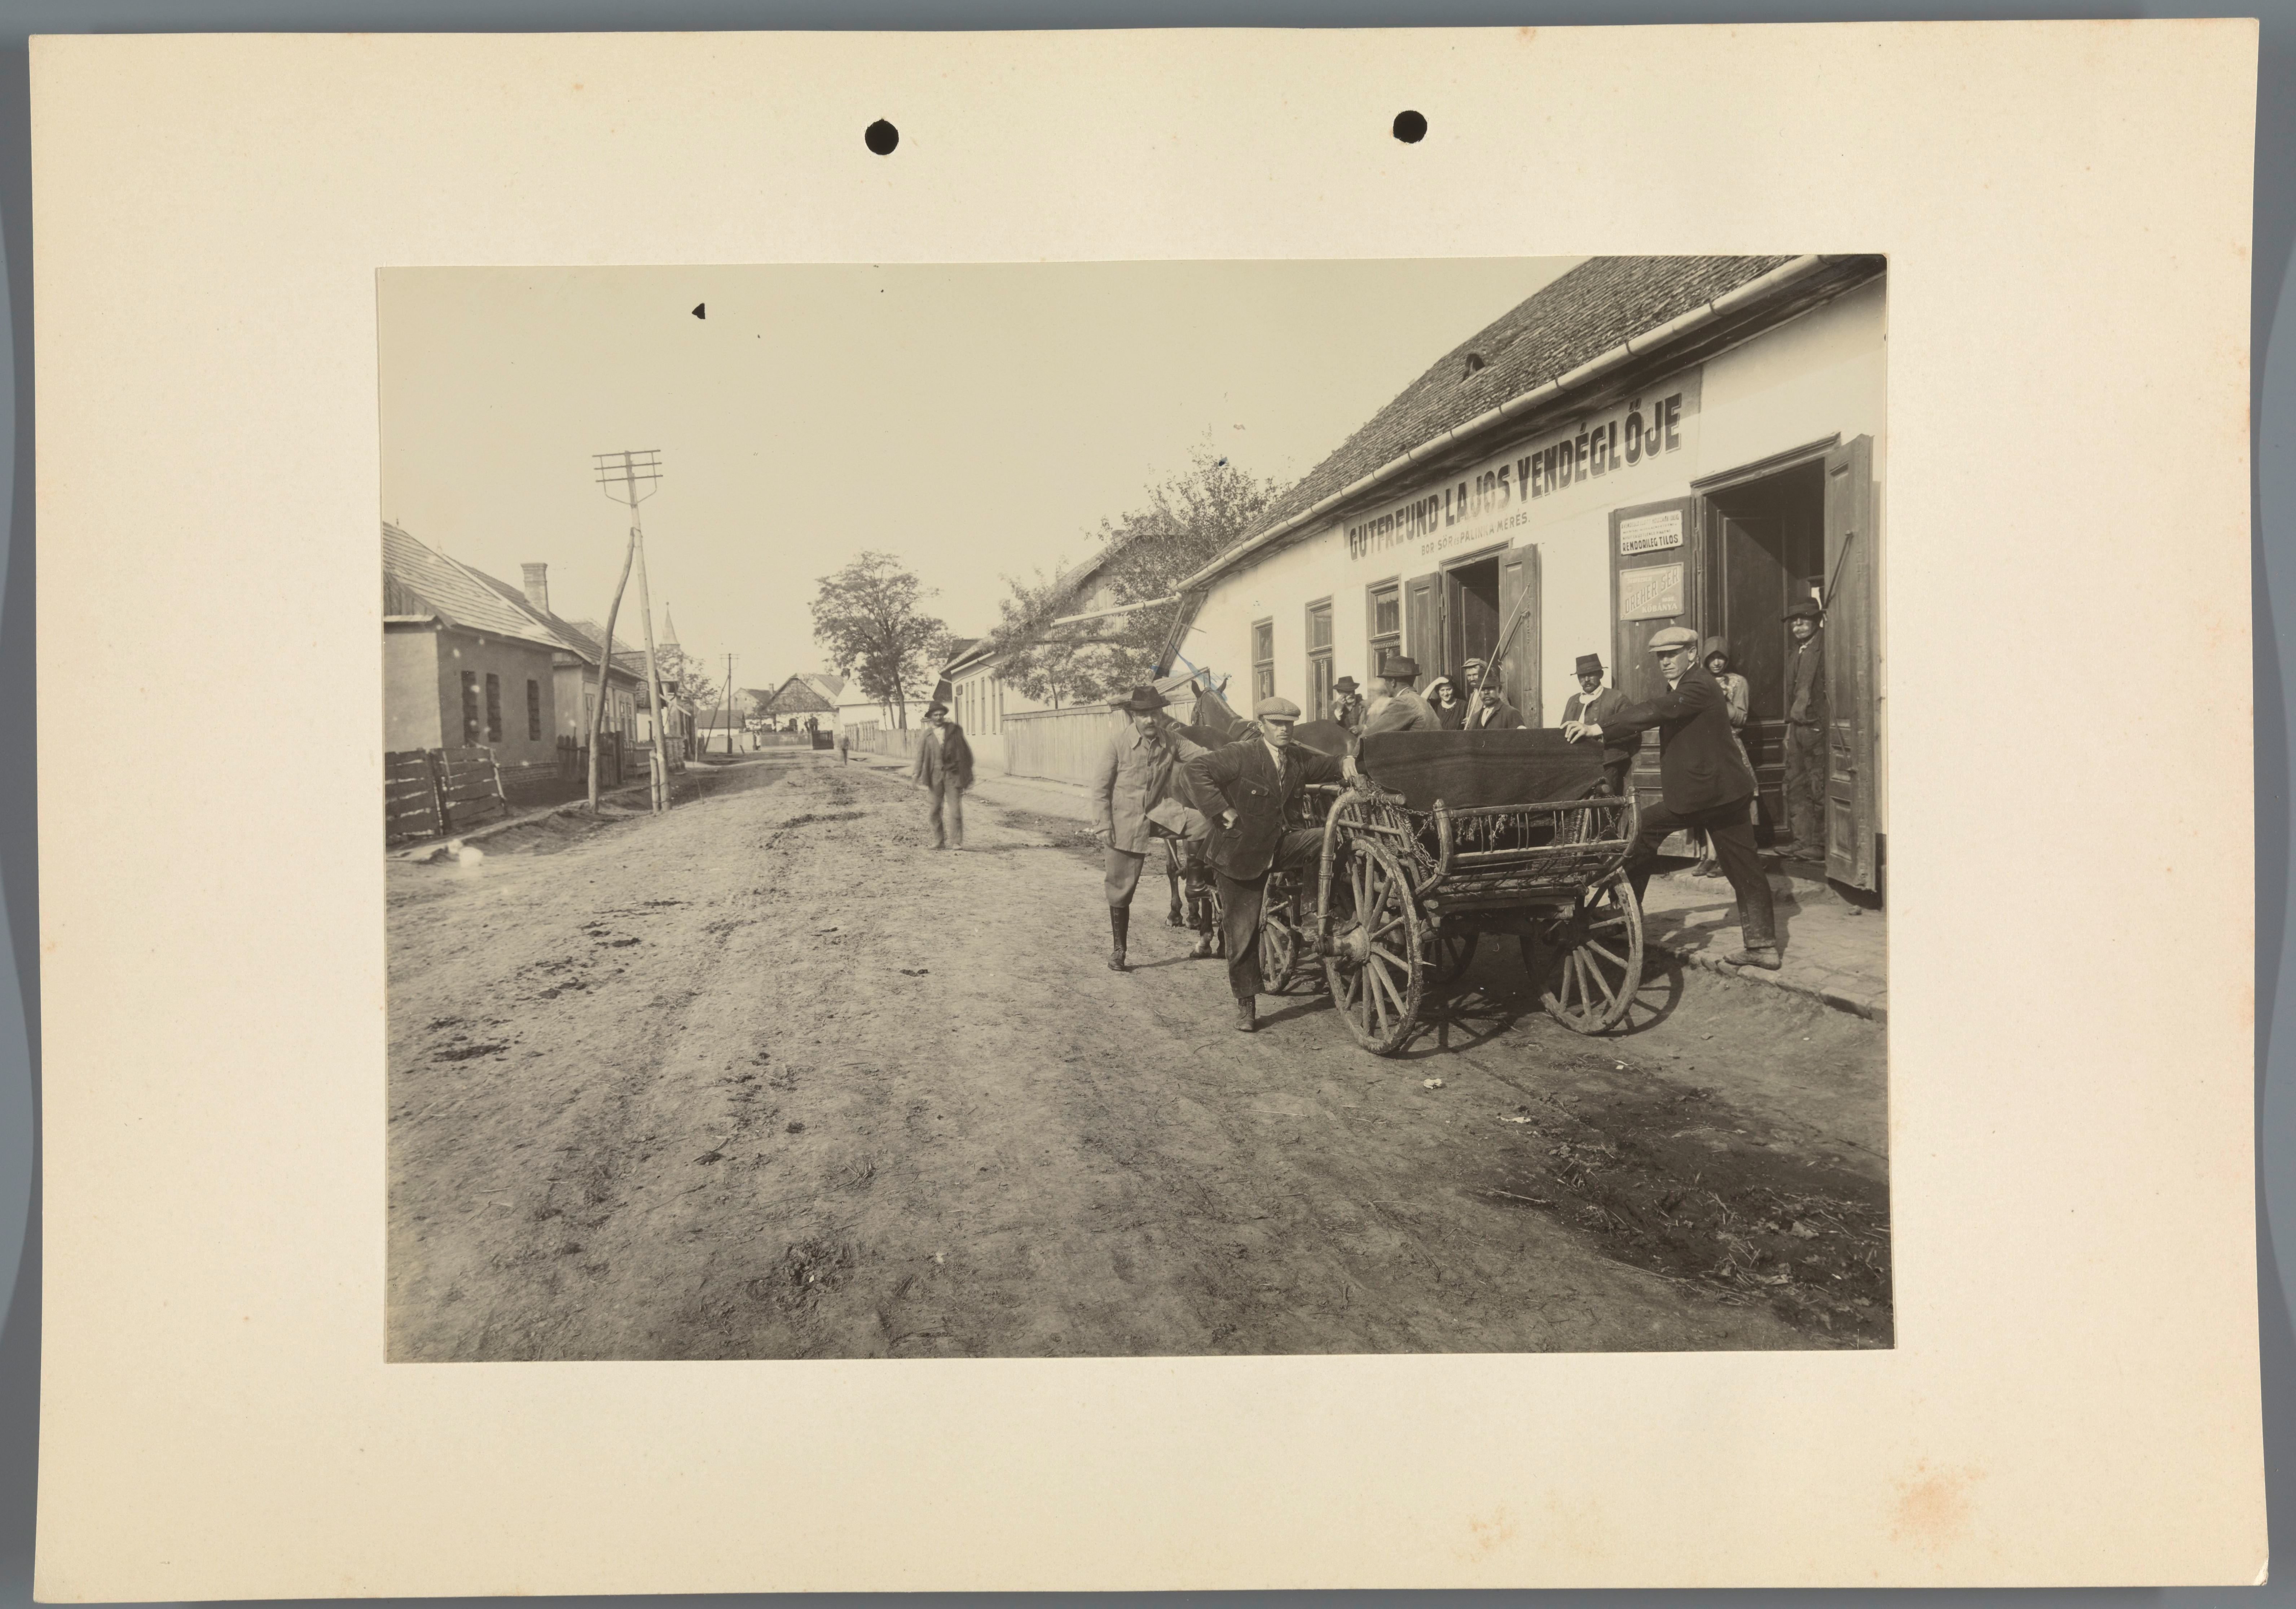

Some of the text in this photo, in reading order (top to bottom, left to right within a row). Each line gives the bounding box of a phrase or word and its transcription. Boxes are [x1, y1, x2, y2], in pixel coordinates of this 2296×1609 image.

[1350, 392, 1682, 562] GUTFREUND LAJOS VENDÉGLŐJE
[1421, 542, 1434, 556] BOR
[1438, 534, 1453, 550] SÖR
[1659, 533, 1678, 546] TILOS
[1625, 581, 1657, 613] DREHER
